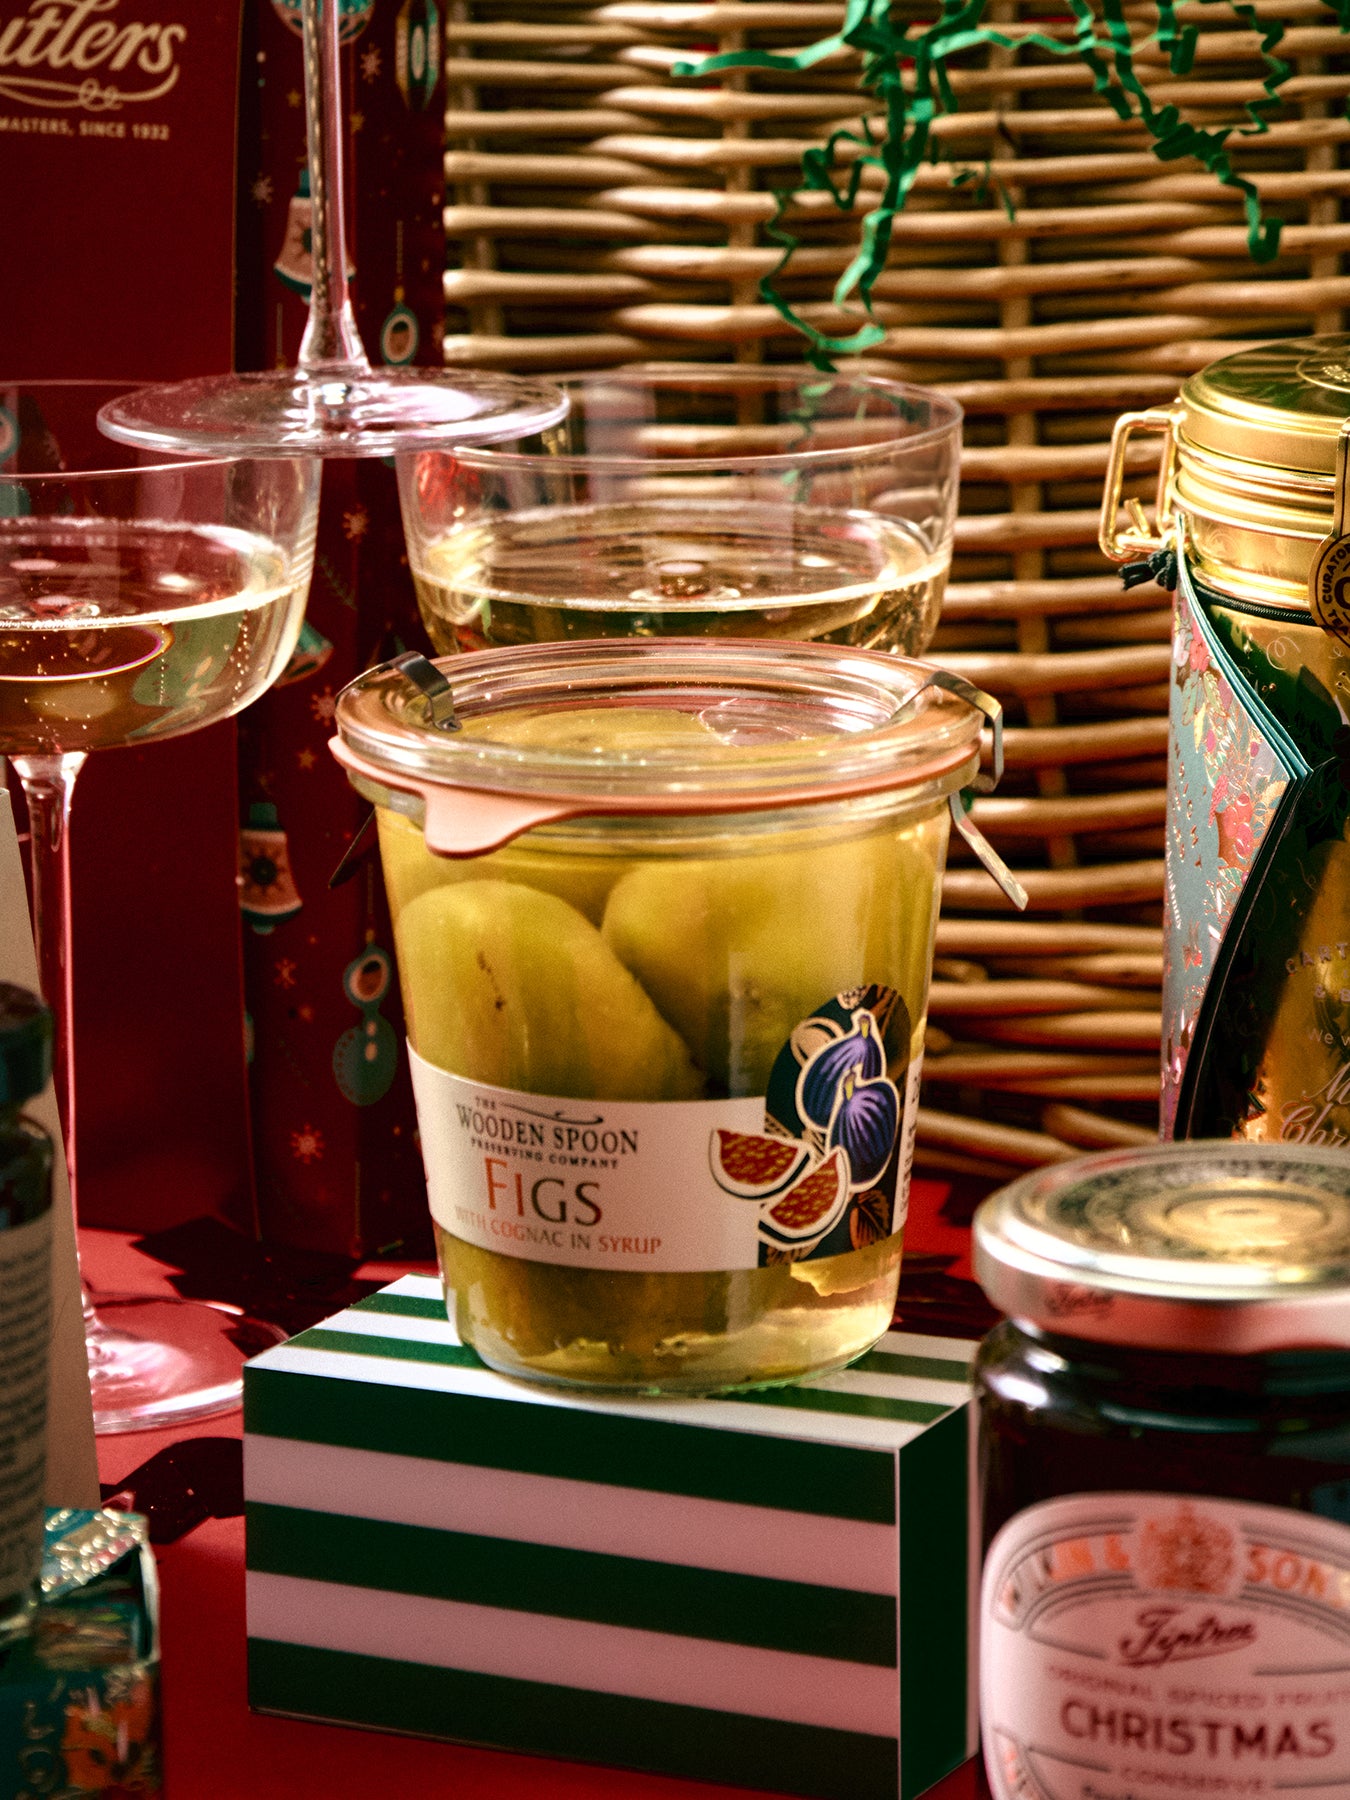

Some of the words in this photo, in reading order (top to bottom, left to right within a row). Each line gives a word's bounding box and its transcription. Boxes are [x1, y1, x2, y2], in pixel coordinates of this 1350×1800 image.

[79, 120, 126, 139] SINCE
[1308, 1028, 1334, 1046] We
[475, 1096, 497, 1110] THE
[456, 1103, 544, 1147] WOODEN
[553, 1127, 638, 1155] SPOON
[471, 1138, 543, 1162] PRESERVING
[549, 1152, 618, 1169] COMPANY
[485, 1157, 603, 1227] FIGS
[455, 1206, 486, 1230] WITH
[491, 1216, 564, 1246] COGNAC
[571, 1233, 591, 1250] IN
[599, 1236, 662, 1254] SYRUP
[1061, 1696, 1335, 1759] CHRISTMAS
